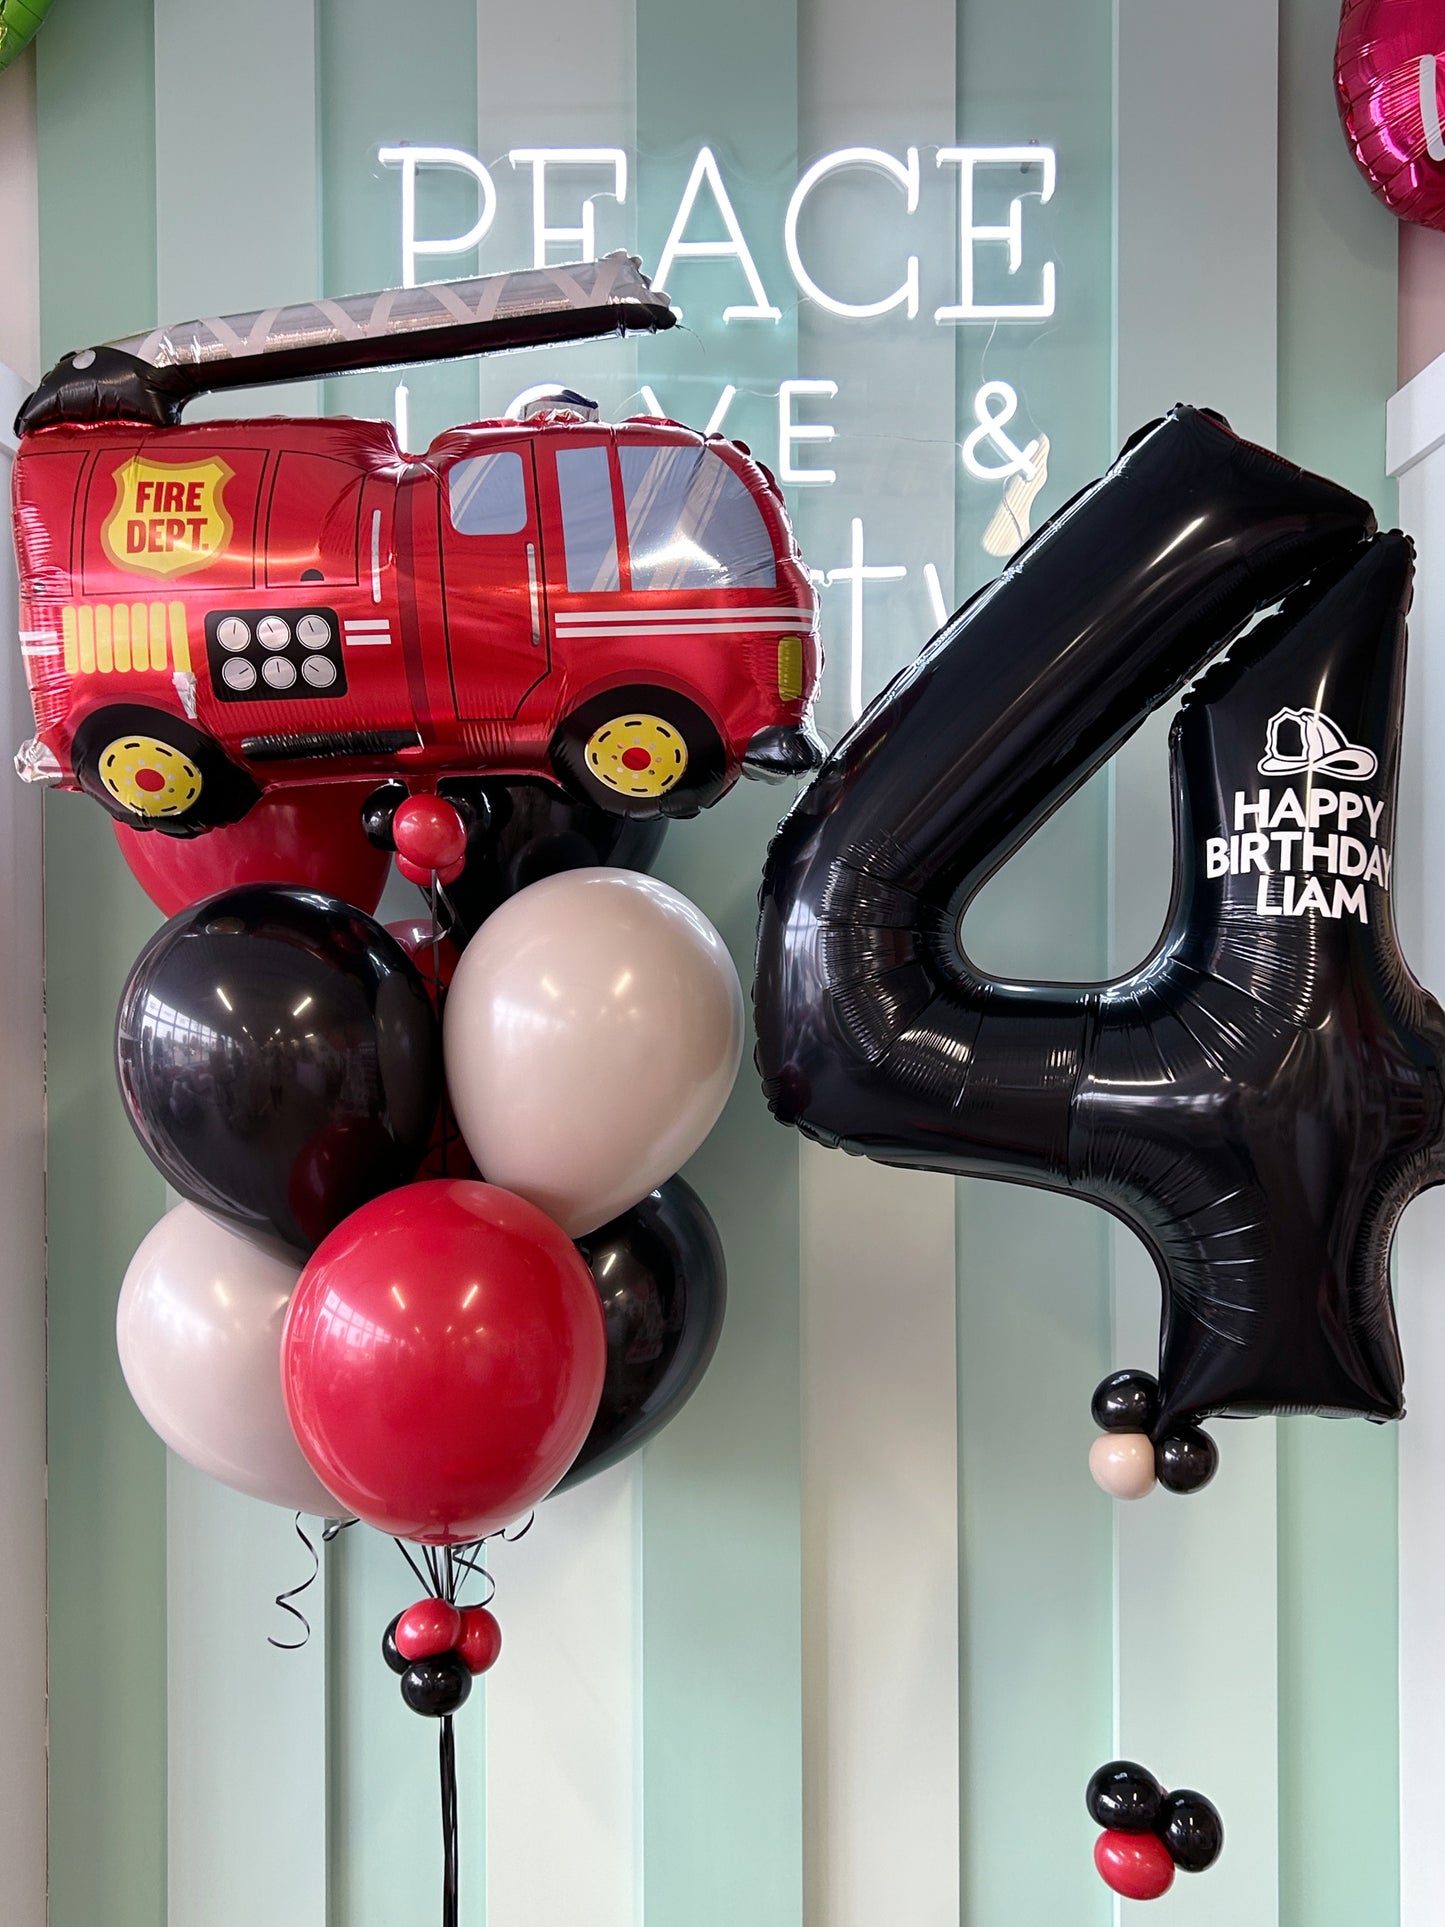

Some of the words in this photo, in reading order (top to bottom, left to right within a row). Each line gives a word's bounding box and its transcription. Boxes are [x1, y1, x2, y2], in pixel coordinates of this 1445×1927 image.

[378, 146, 1057, 324] PEACE
[135, 481, 205, 513] FIRE
[126, 518, 209, 554] DEPT.
[1233, 787, 1385, 839] HAPPY
[1206, 831, 1392, 891] BIRTHDAY
[1256, 874, 1368, 924] LIAM
